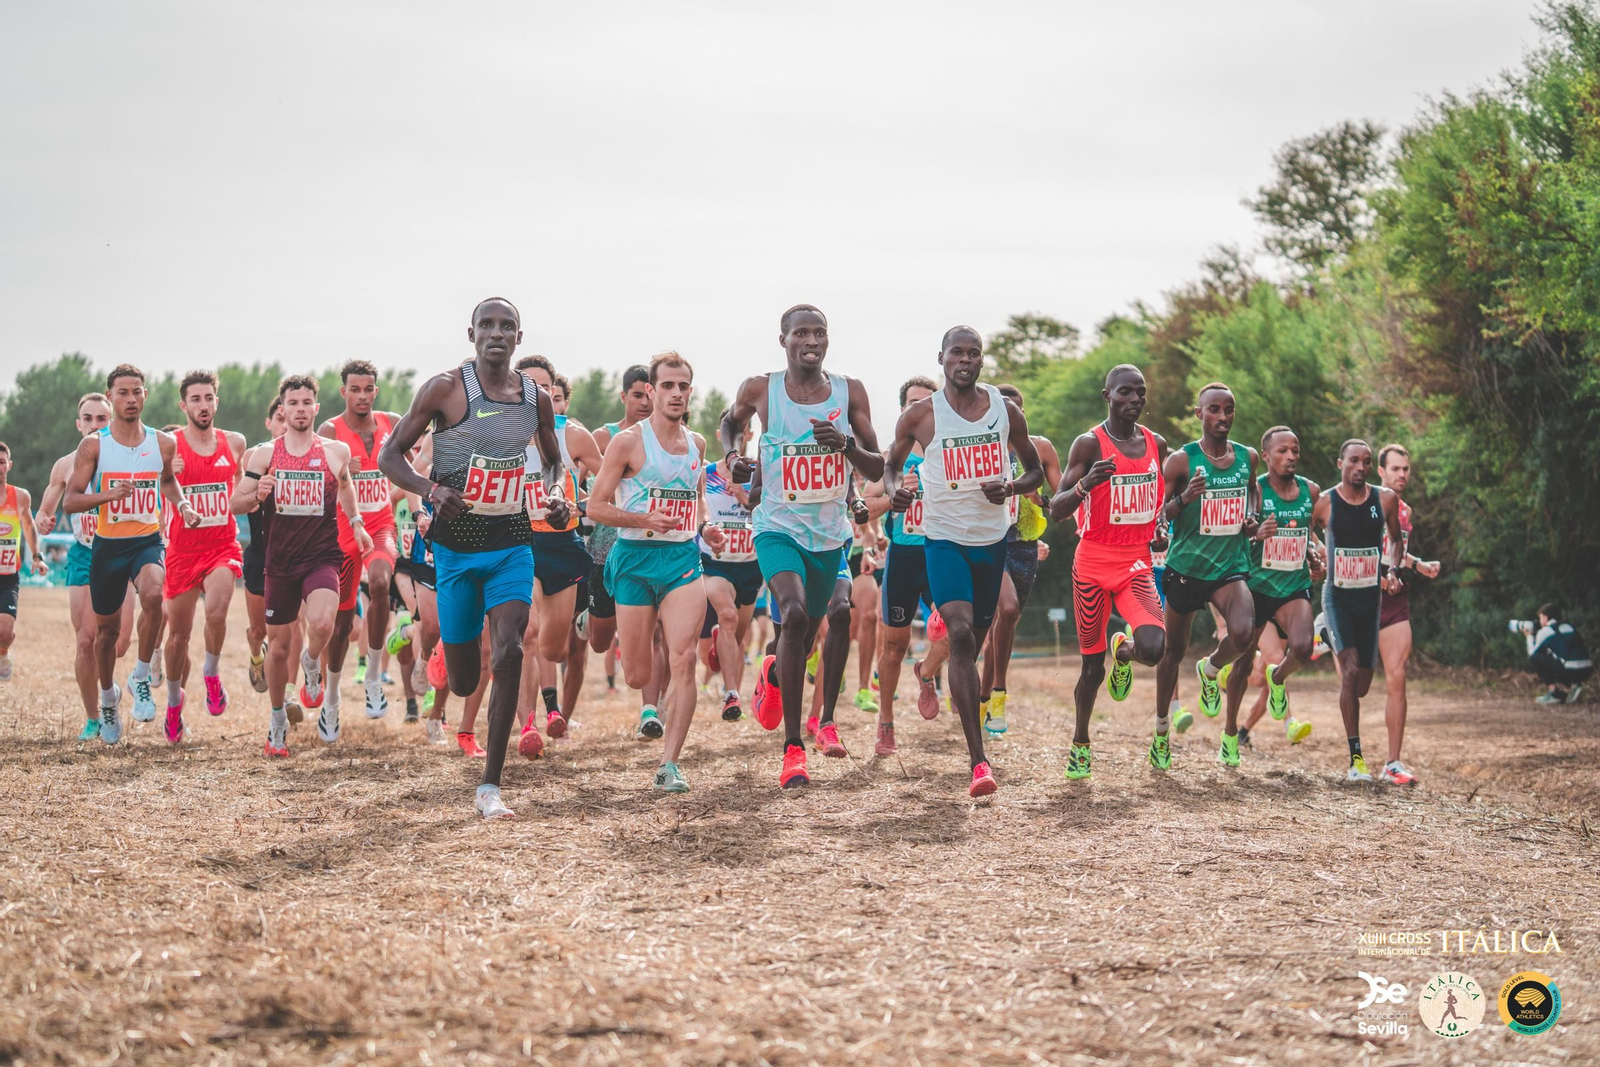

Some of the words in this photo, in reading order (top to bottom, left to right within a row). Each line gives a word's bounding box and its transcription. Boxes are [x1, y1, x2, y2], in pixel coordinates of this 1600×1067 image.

[465, 466, 525, 504] BETT
[782, 453, 845, 491] KOECH
[109, 489, 156, 514] OLIVO
[275, 480, 292, 505] LAS
[294, 480, 323, 506] HERAS
